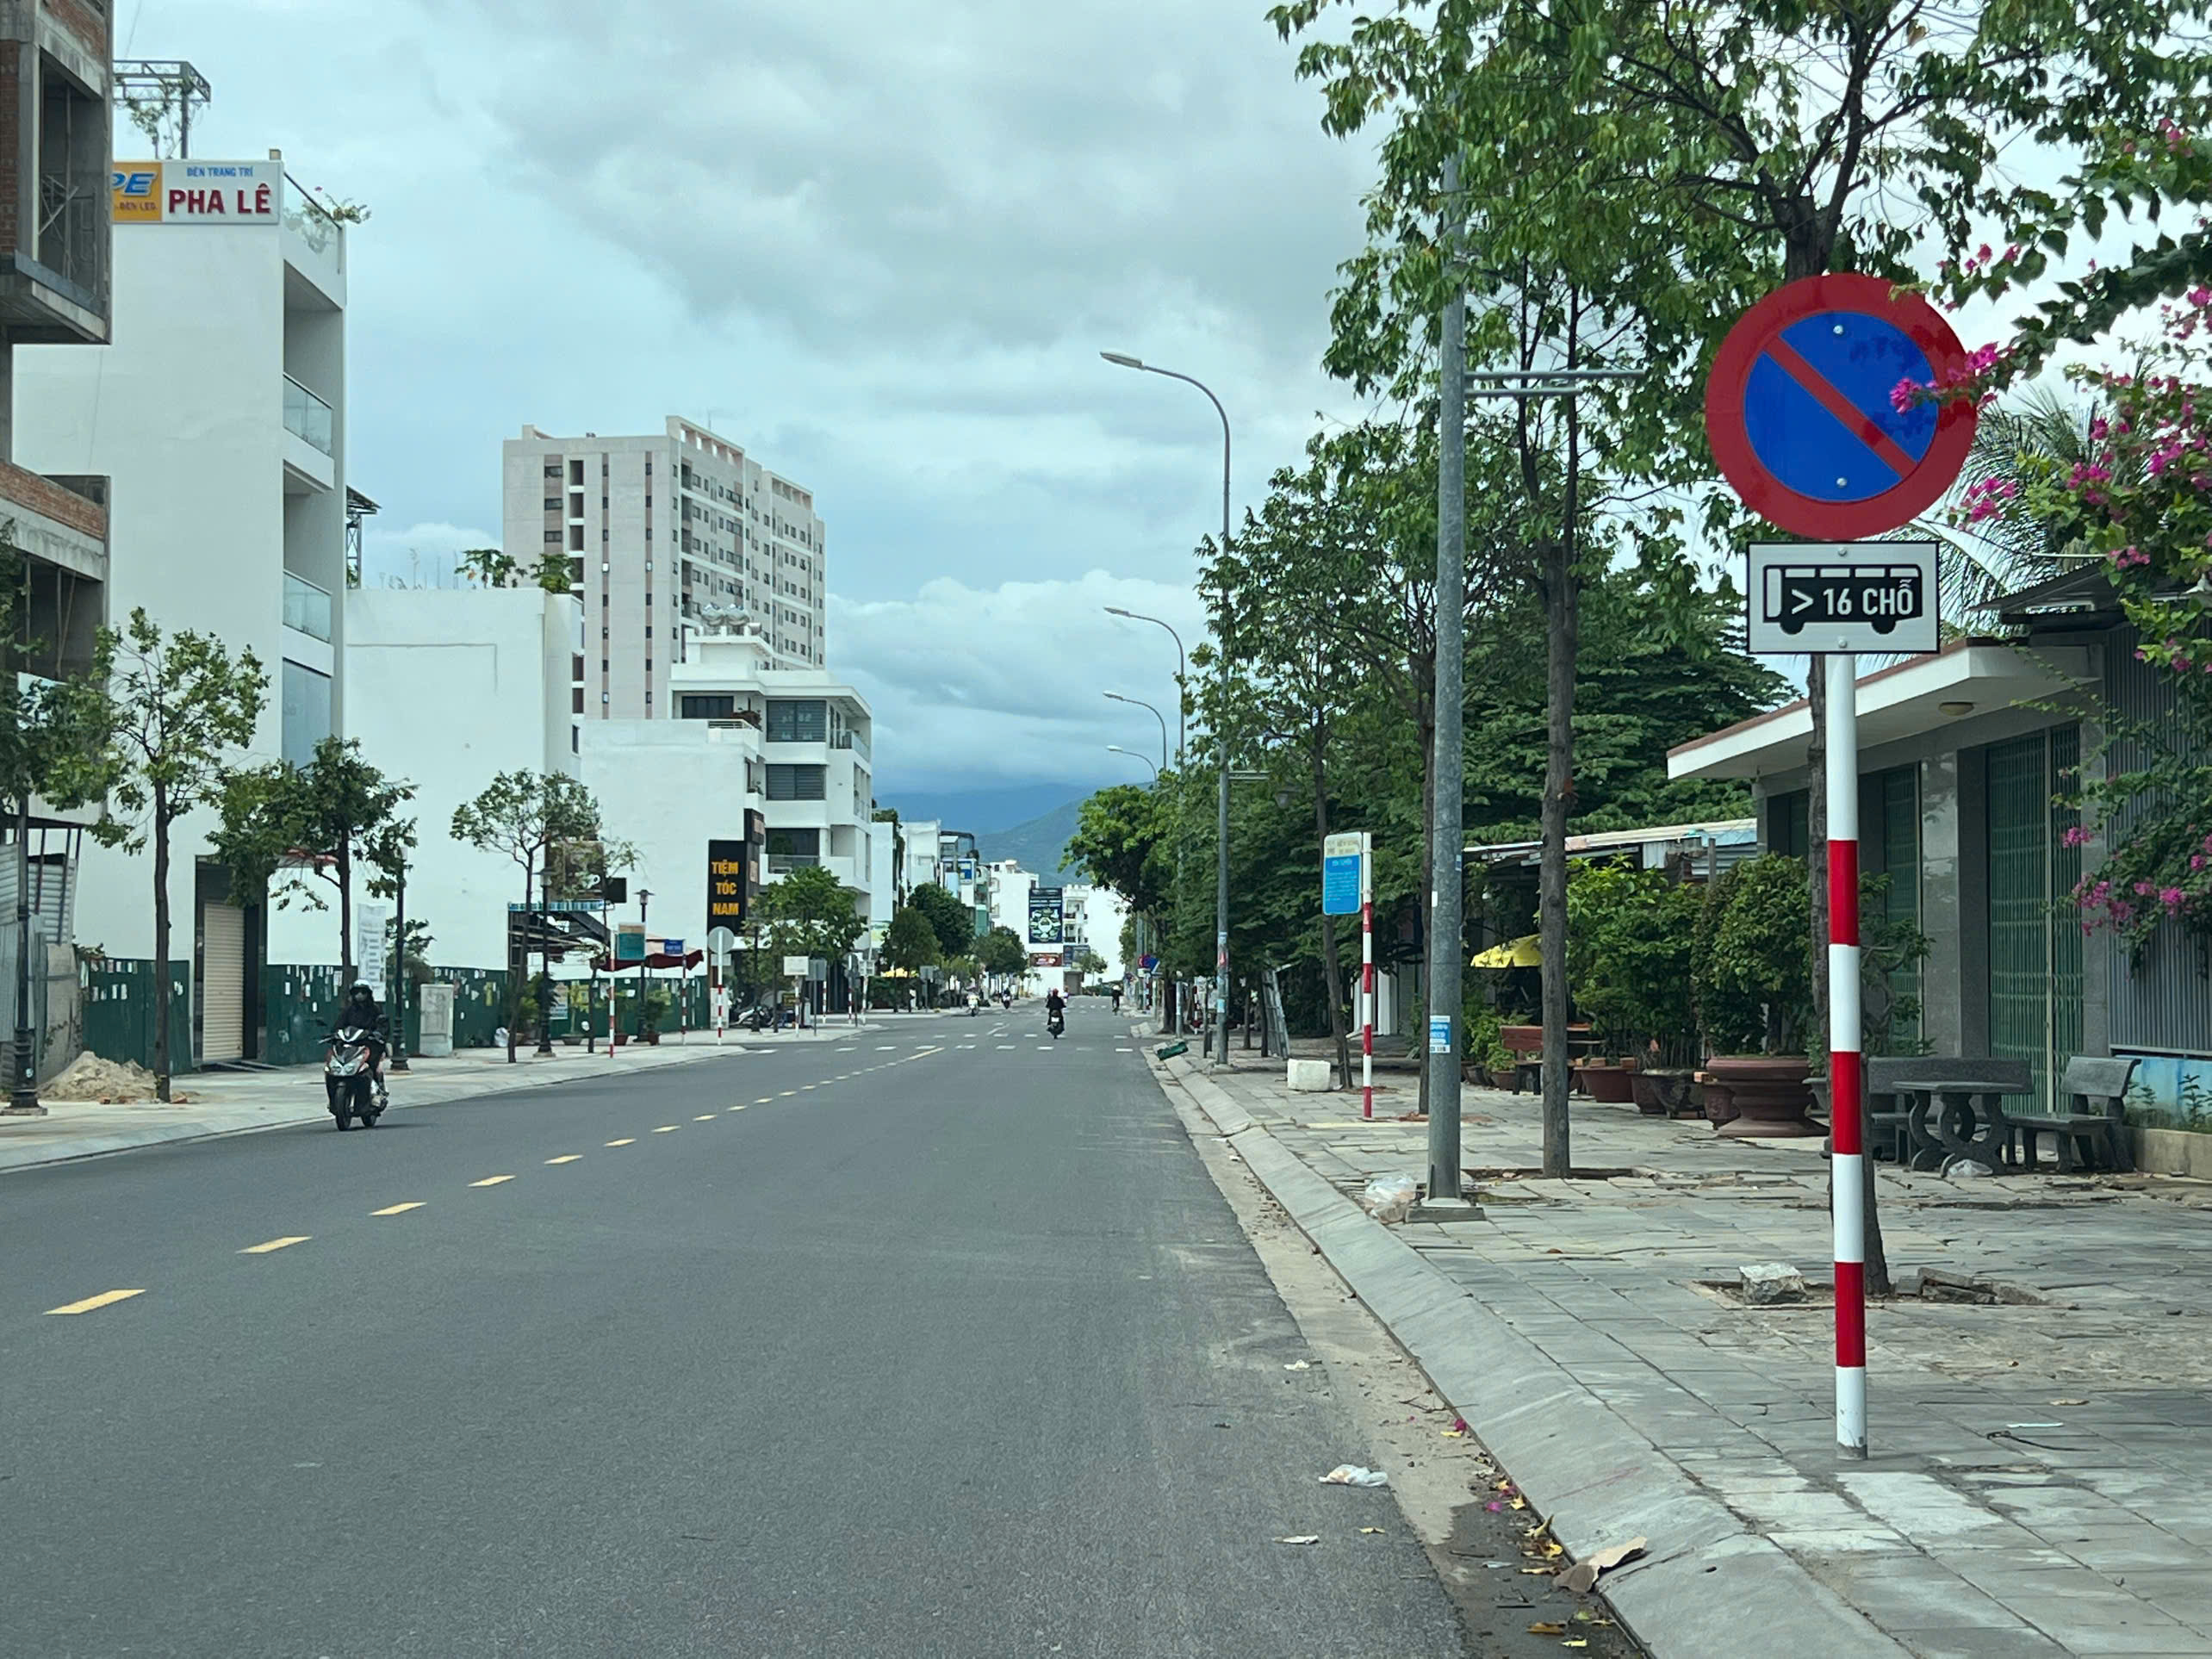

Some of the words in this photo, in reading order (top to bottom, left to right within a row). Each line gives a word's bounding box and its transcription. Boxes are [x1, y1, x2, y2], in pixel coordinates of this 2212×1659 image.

[208, 166, 236, 177] TRANG
[239, 166, 253, 177] TRÍ
[169, 190, 225, 214] PHA
[237, 183, 270, 214] LÊ
[1823, 587, 1852, 615] 16
[1862, 579, 1913, 615] CHỖ
[711, 859, 739, 877] TIỆM
[715, 879, 737, 895] TÓC
[712, 902, 739, 916] NAM
